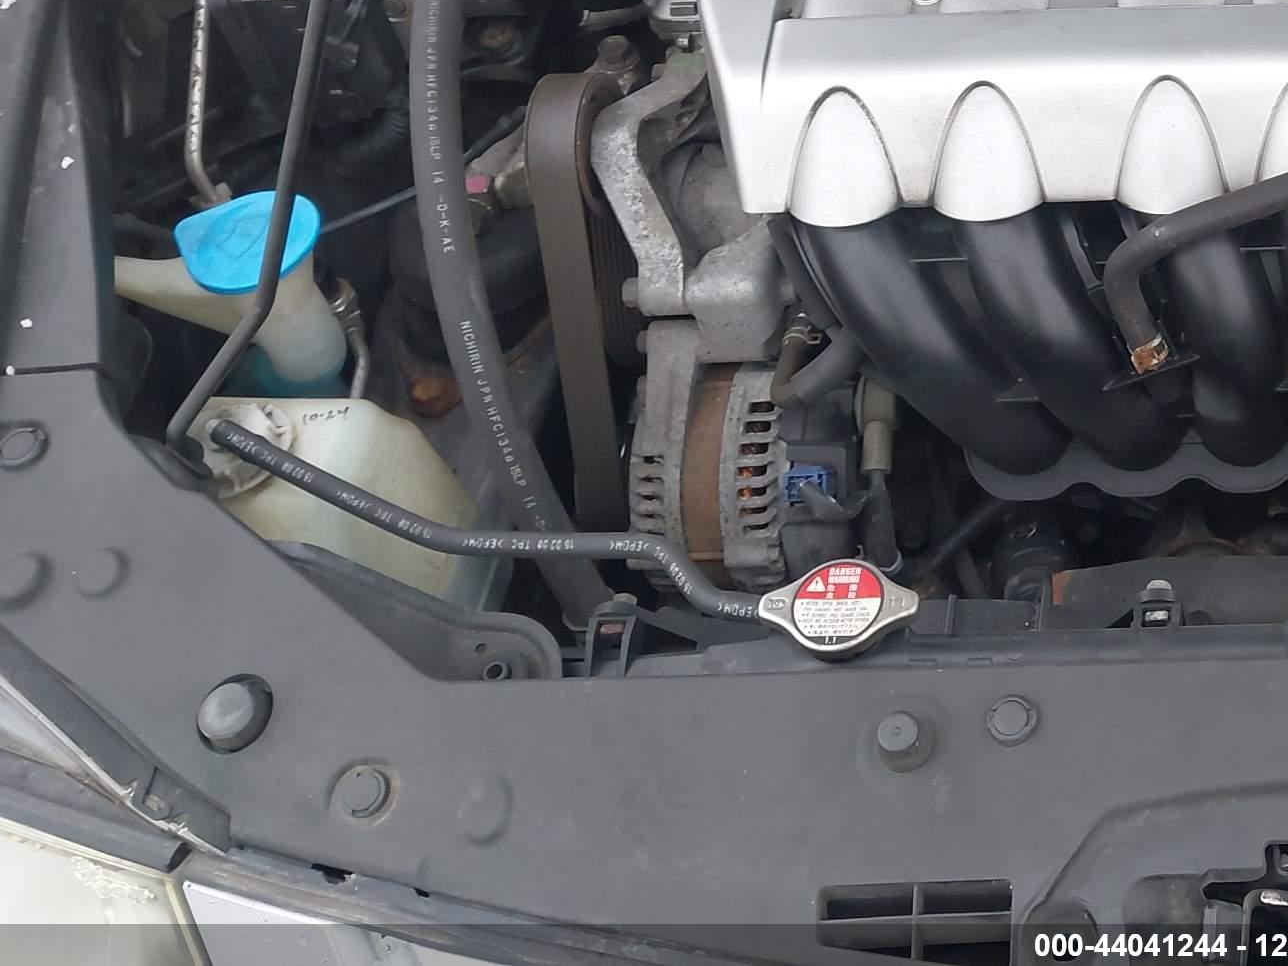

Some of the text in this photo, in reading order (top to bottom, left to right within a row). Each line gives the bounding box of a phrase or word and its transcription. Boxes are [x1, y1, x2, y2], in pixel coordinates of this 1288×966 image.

[460, 320, 485, 374] NICHIRIN
[476, 378, 494, 404] JPN
[828, 566, 863, 576] DANGER
[824, 635, 837, 645] 1.1
